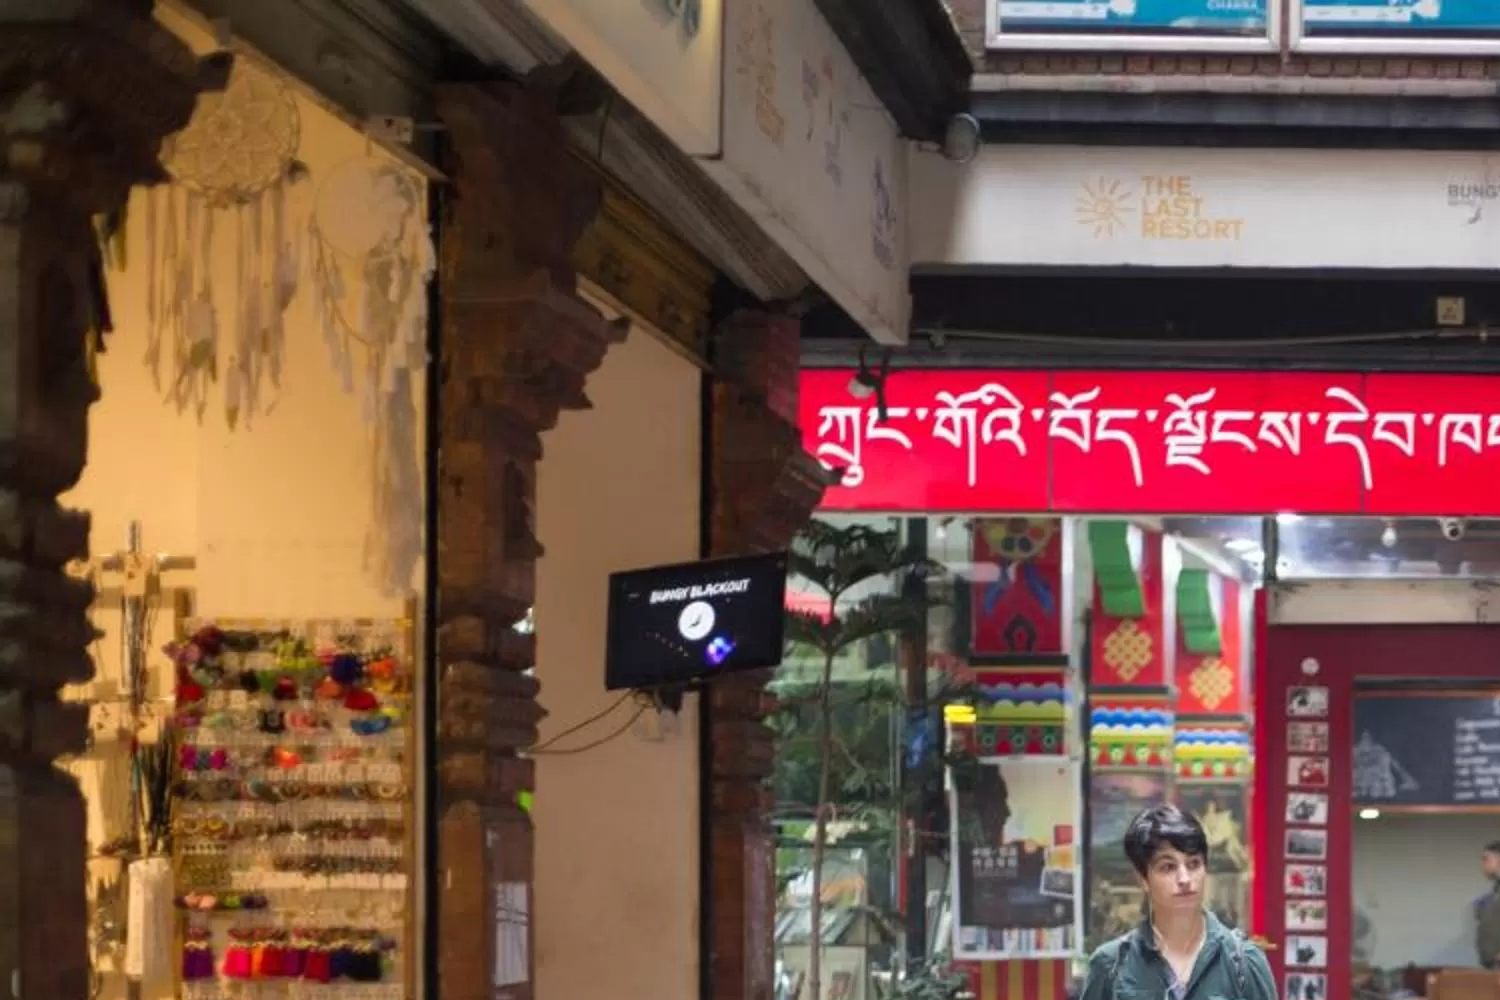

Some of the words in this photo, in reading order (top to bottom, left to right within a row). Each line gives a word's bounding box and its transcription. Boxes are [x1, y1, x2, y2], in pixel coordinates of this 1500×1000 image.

[1141, 175, 1192, 196] THE
[1141, 197, 1204, 217] LAST
[1141, 219, 1245, 240] RESORT
[690, 578, 752, 599] BLACKOUT
